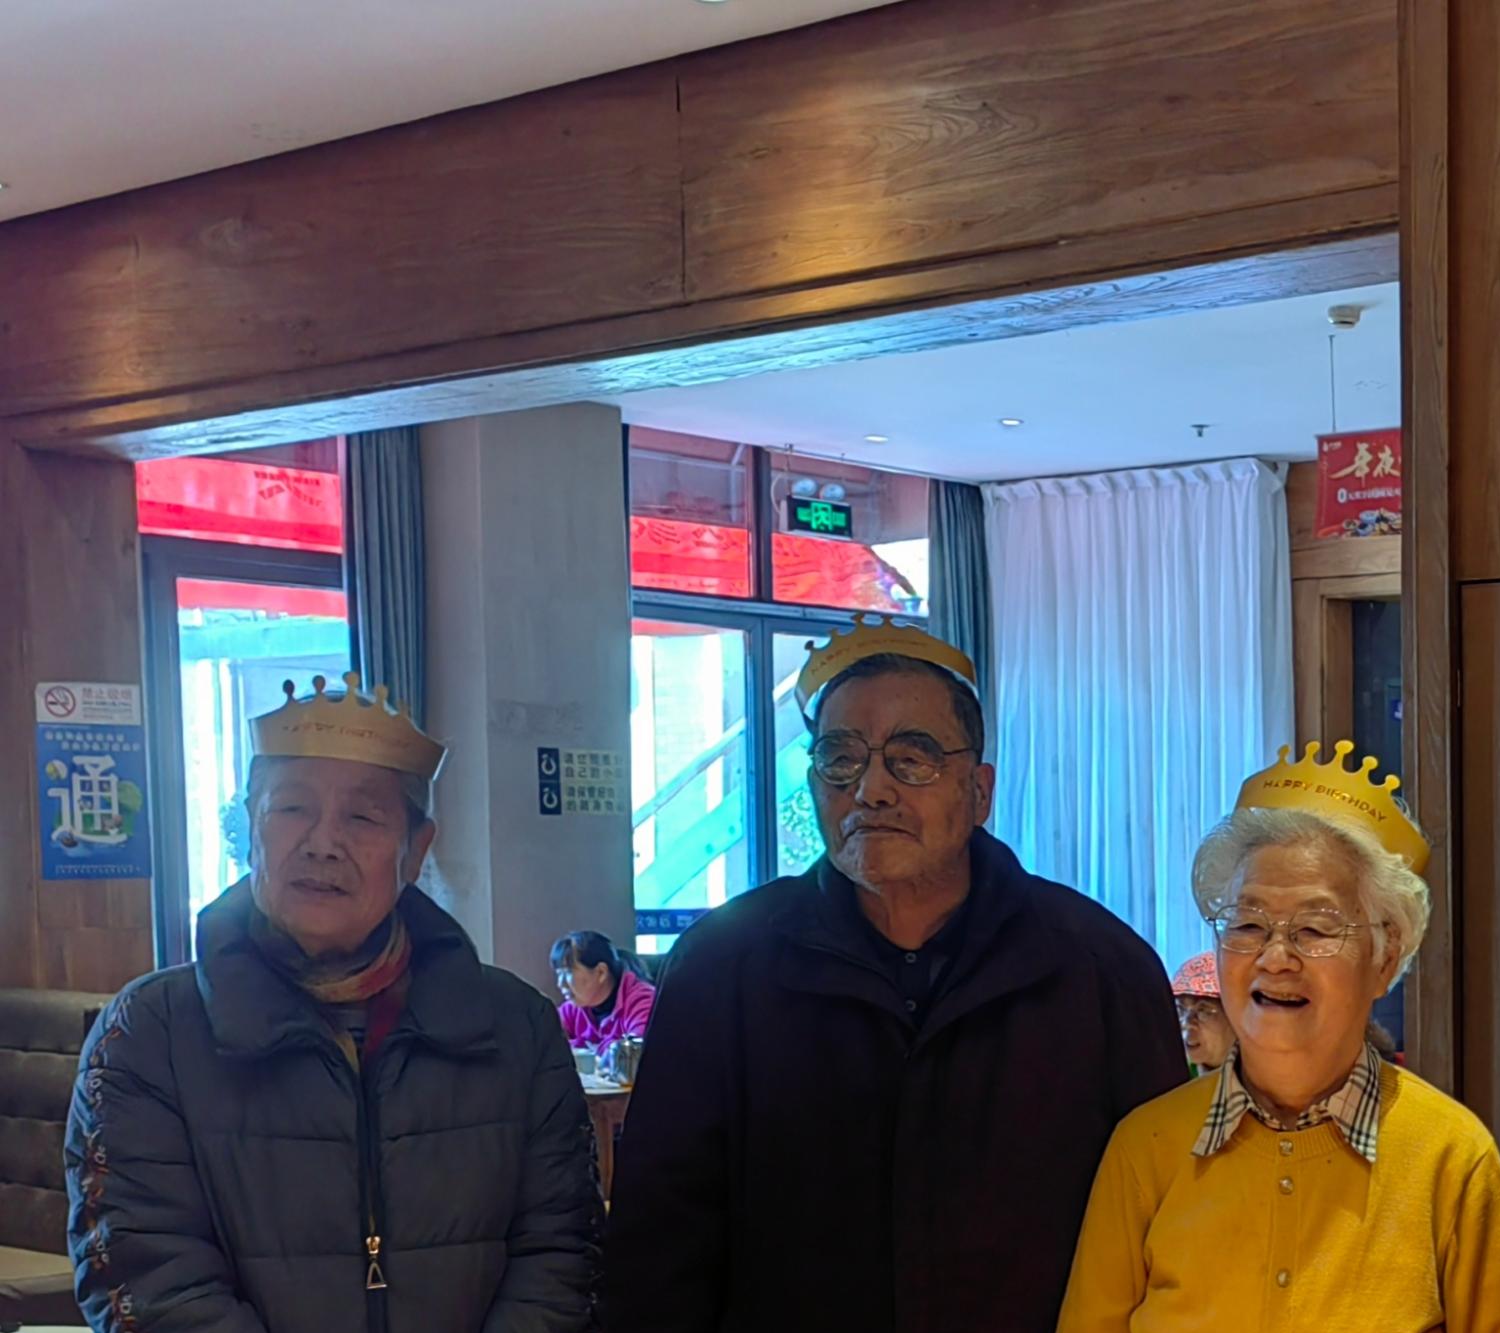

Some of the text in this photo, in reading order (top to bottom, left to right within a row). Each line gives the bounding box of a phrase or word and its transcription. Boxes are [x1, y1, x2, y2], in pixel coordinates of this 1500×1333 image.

[1329, 442, 1400, 488] 年夜
[47, 755, 128, 845] 通
[1263, 779, 1388, 822] HAPPY BIRTHDAY
